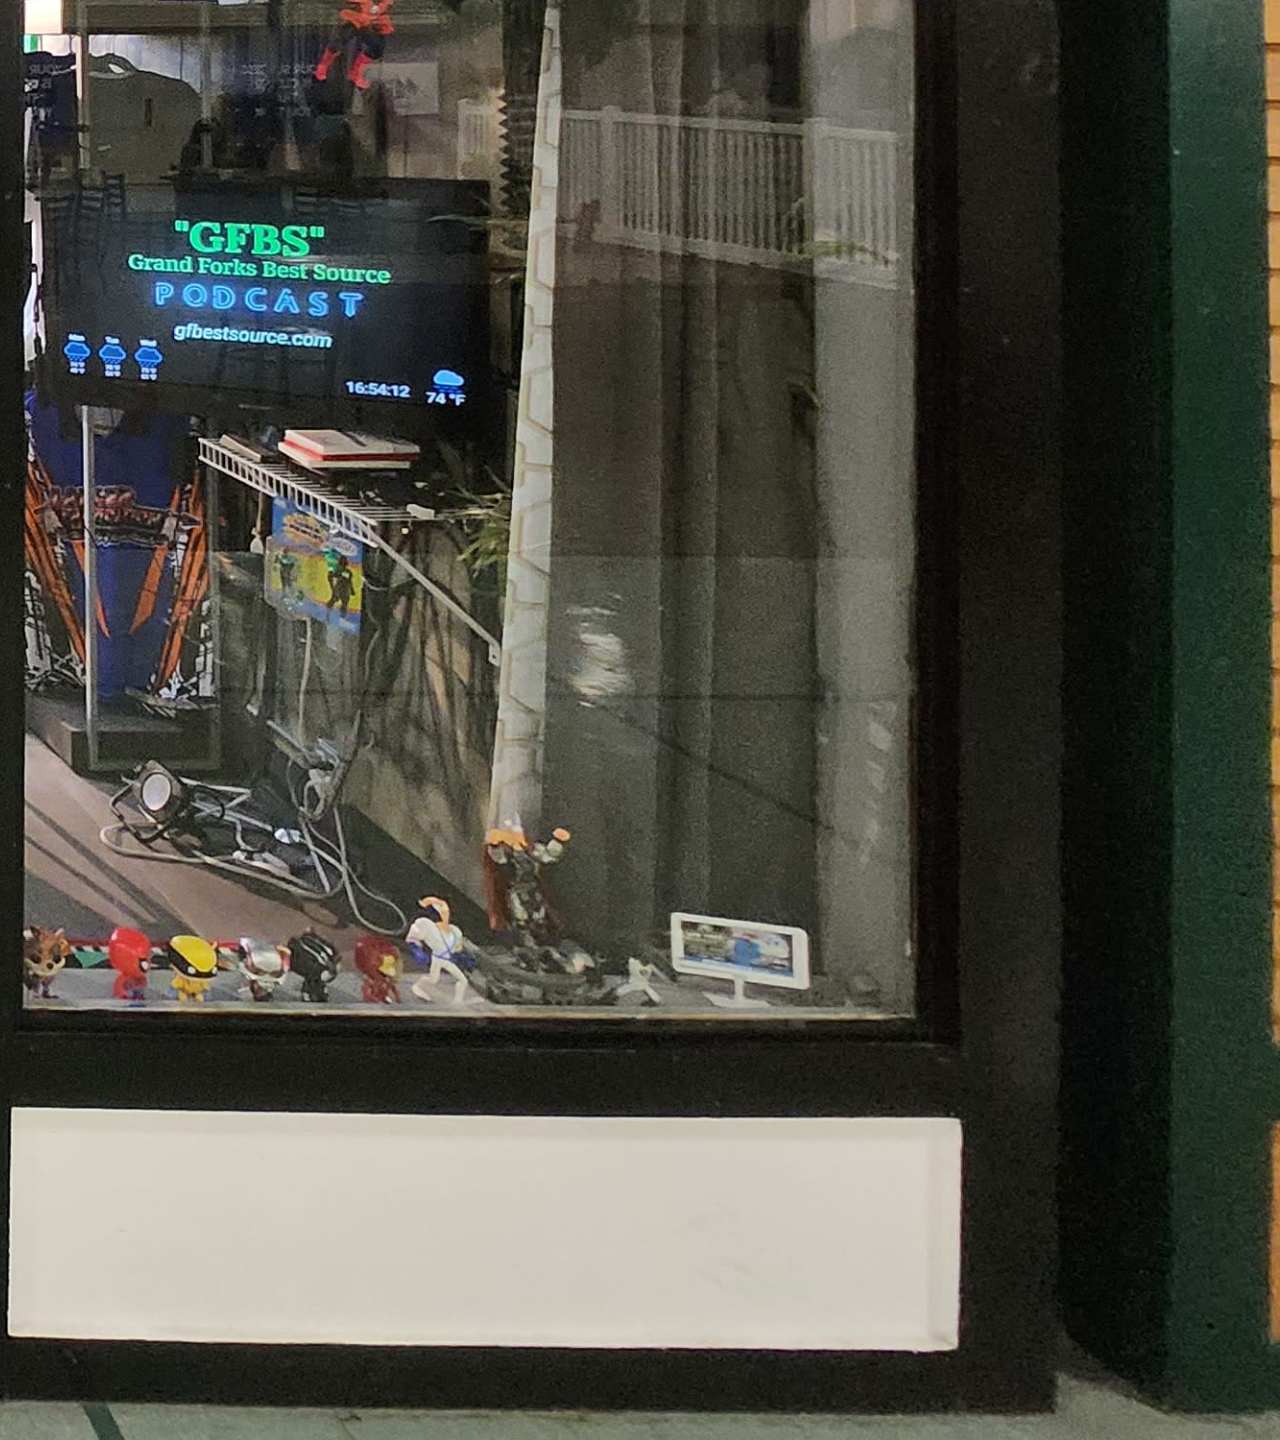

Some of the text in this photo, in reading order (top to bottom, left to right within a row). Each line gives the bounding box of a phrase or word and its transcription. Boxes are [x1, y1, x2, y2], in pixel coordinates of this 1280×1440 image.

[174, 220, 325, 257] "GFBS"
[128, 254, 391, 284] Grand Forks Best Source
[155, 282, 365, 318] PODCAST
[173, 323, 333, 348] gfbestsource.com
[345, 381, 411, 398] 16:54:12
